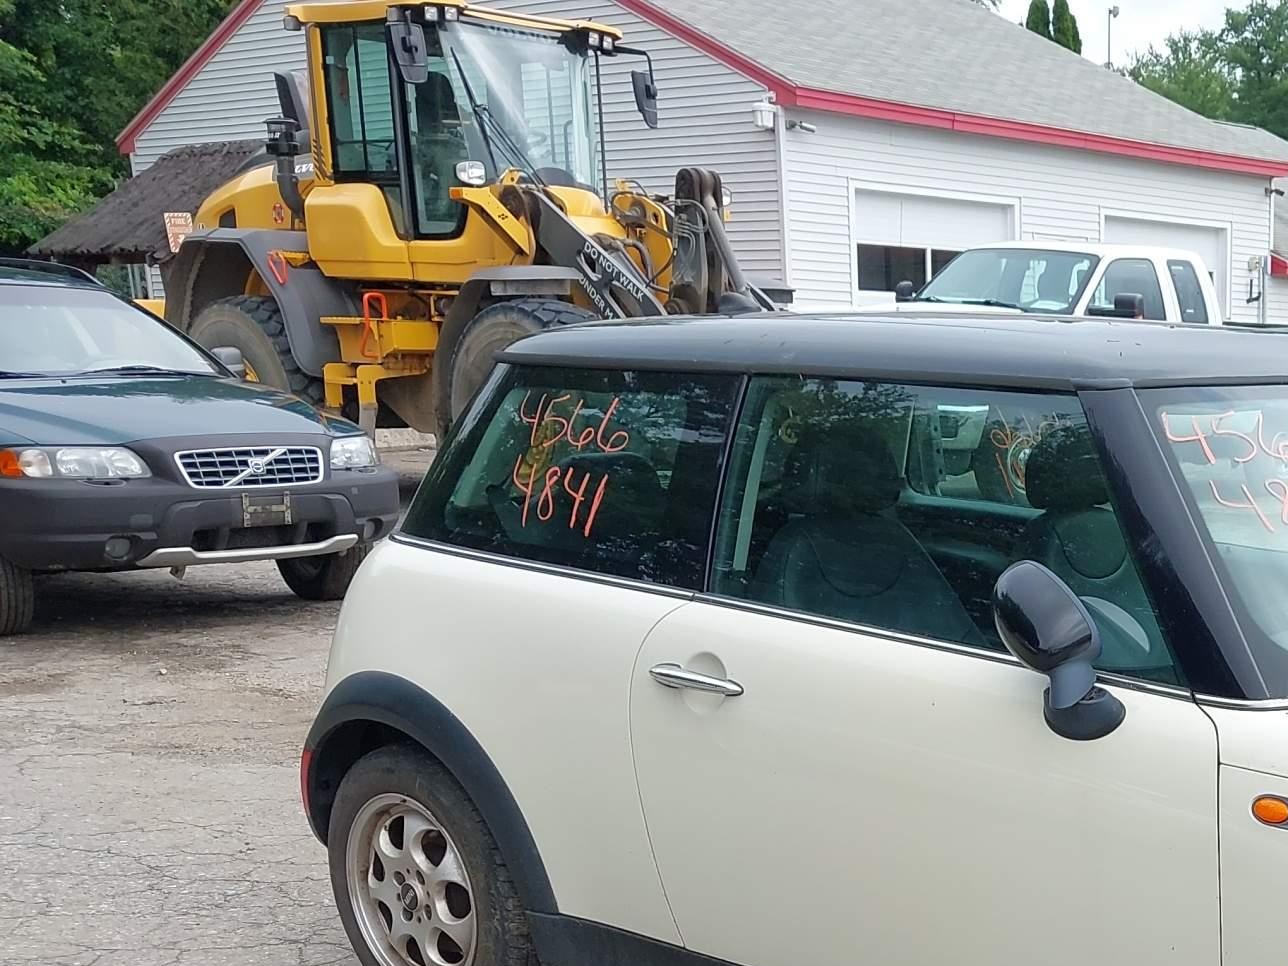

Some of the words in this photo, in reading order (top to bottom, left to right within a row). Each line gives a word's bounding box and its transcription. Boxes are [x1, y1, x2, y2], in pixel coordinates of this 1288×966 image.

[578, 276, 605, 312] UNDER
[584, 241, 598, 259] DO
[598, 256, 619, 277] NOT
[619, 273, 644, 302] WALK
[520, 389, 630, 454] 4566
[513, 453, 610, 538] 4841
